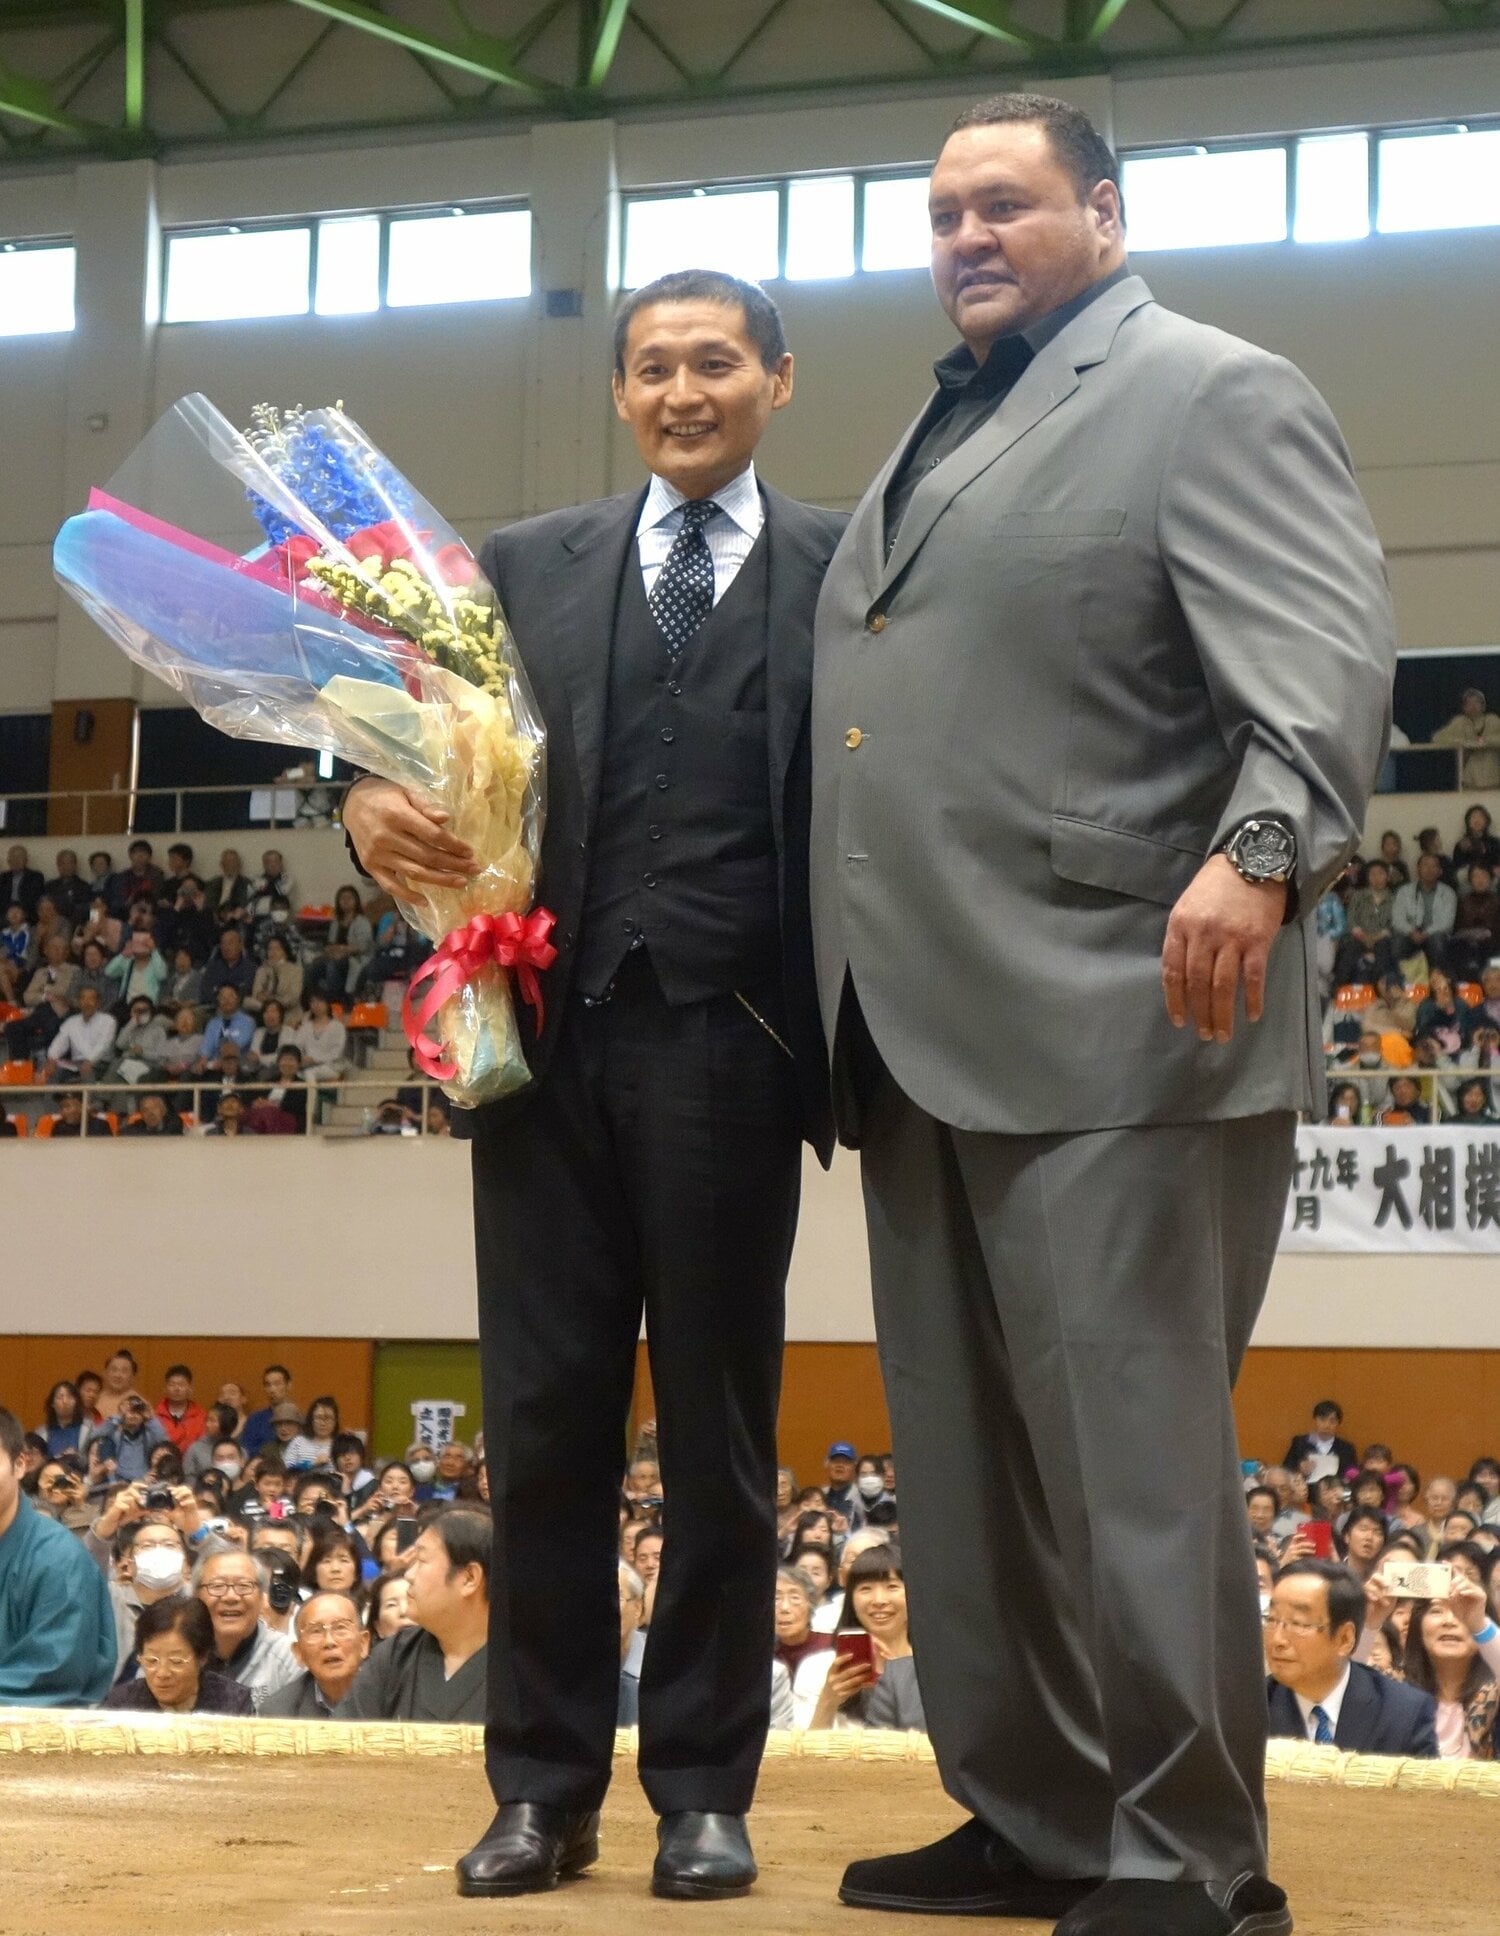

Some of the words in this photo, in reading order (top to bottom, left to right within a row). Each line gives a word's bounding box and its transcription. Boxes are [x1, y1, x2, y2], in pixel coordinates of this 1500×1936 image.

[1292, 1195, 1320, 1232] 月
[1374, 1142, 1500, 1231] 大相撲
